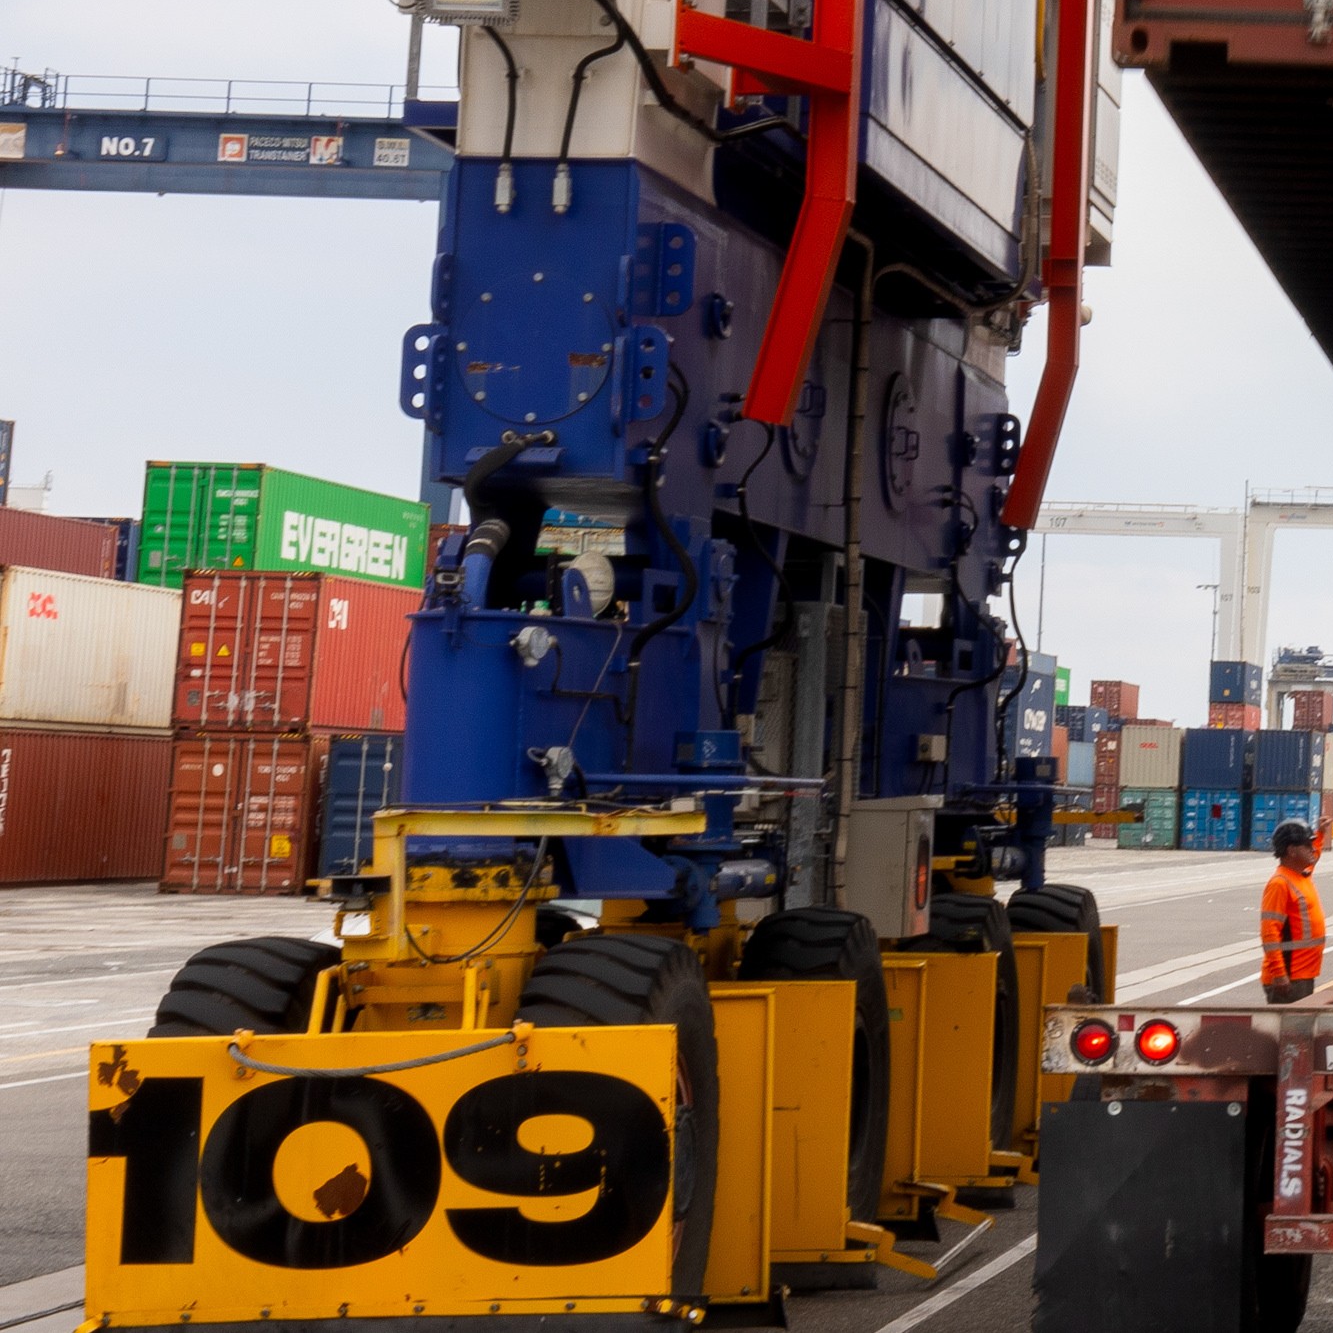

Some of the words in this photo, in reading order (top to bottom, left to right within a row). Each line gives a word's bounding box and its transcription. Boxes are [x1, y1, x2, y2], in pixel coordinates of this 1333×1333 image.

[101, 137, 155, 157] NO.7
[281, 511, 406, 580] EVERGREEN
[1049, 517, 1067, 528] 107
[89, 1071, 672, 1270] 109
[1279, 1089, 1307, 1197] RADIALS
